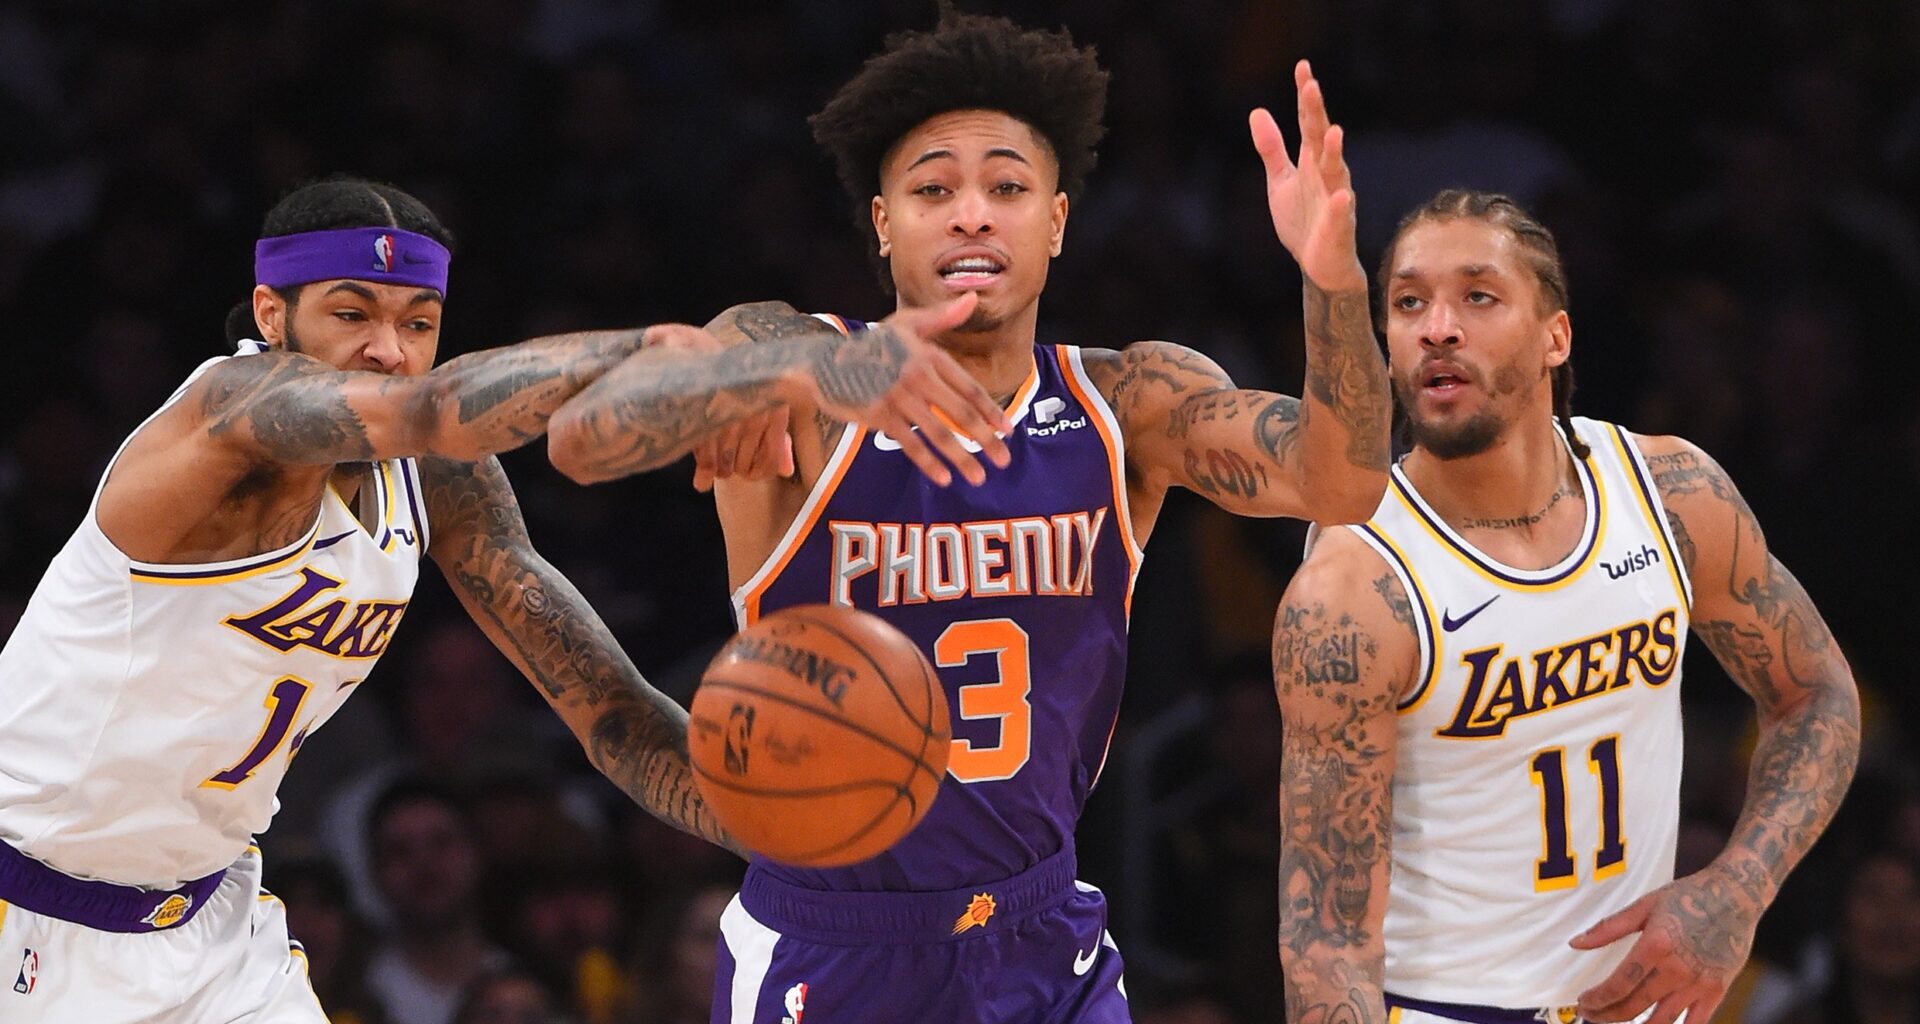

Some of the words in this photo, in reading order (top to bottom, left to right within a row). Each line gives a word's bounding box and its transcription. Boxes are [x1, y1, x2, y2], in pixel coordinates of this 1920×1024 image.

[1026, 415, 1087, 437] PayPal
[828, 506, 1108, 610] PHOENIX
[1599, 544, 1661, 580] wish
[933, 617, 1032, 784] 3
[1432, 606, 1680, 739] LAKERS
[197, 685, 362, 792] 1
[1528, 731, 1629, 893] 11
